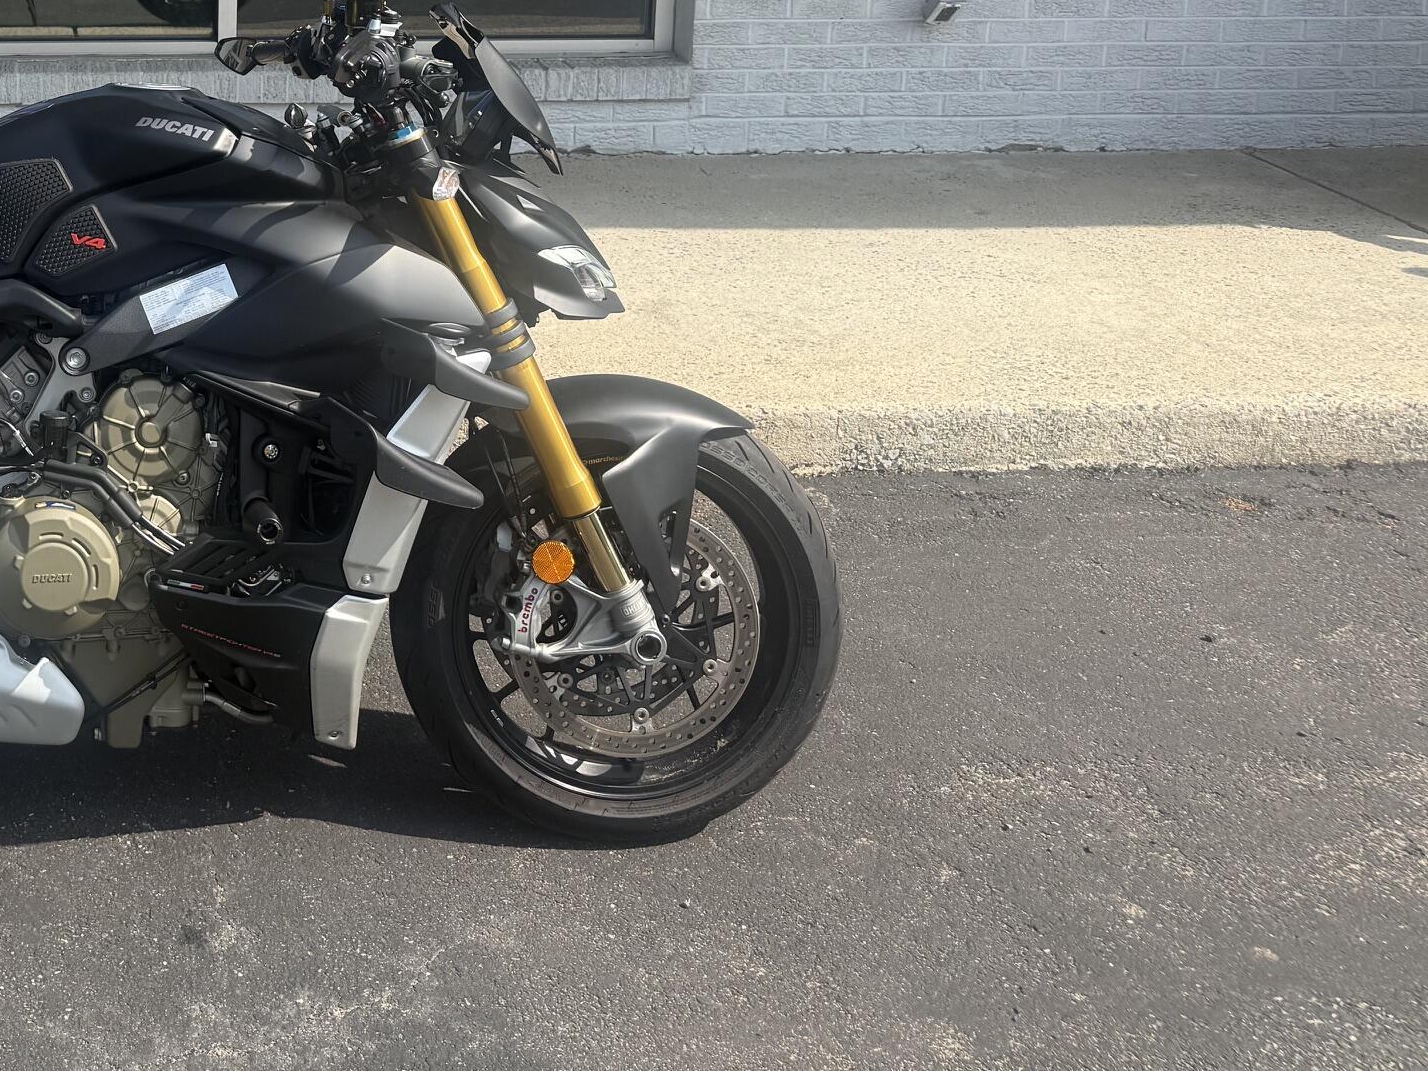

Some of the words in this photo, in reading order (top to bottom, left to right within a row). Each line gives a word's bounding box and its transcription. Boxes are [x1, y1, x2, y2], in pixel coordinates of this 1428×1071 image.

[135, 115, 215, 142] DUCATI
[69, 231, 107, 251] V4
[31, 573, 73, 584] DUCATI
[518, 587, 539, 634] brembo
